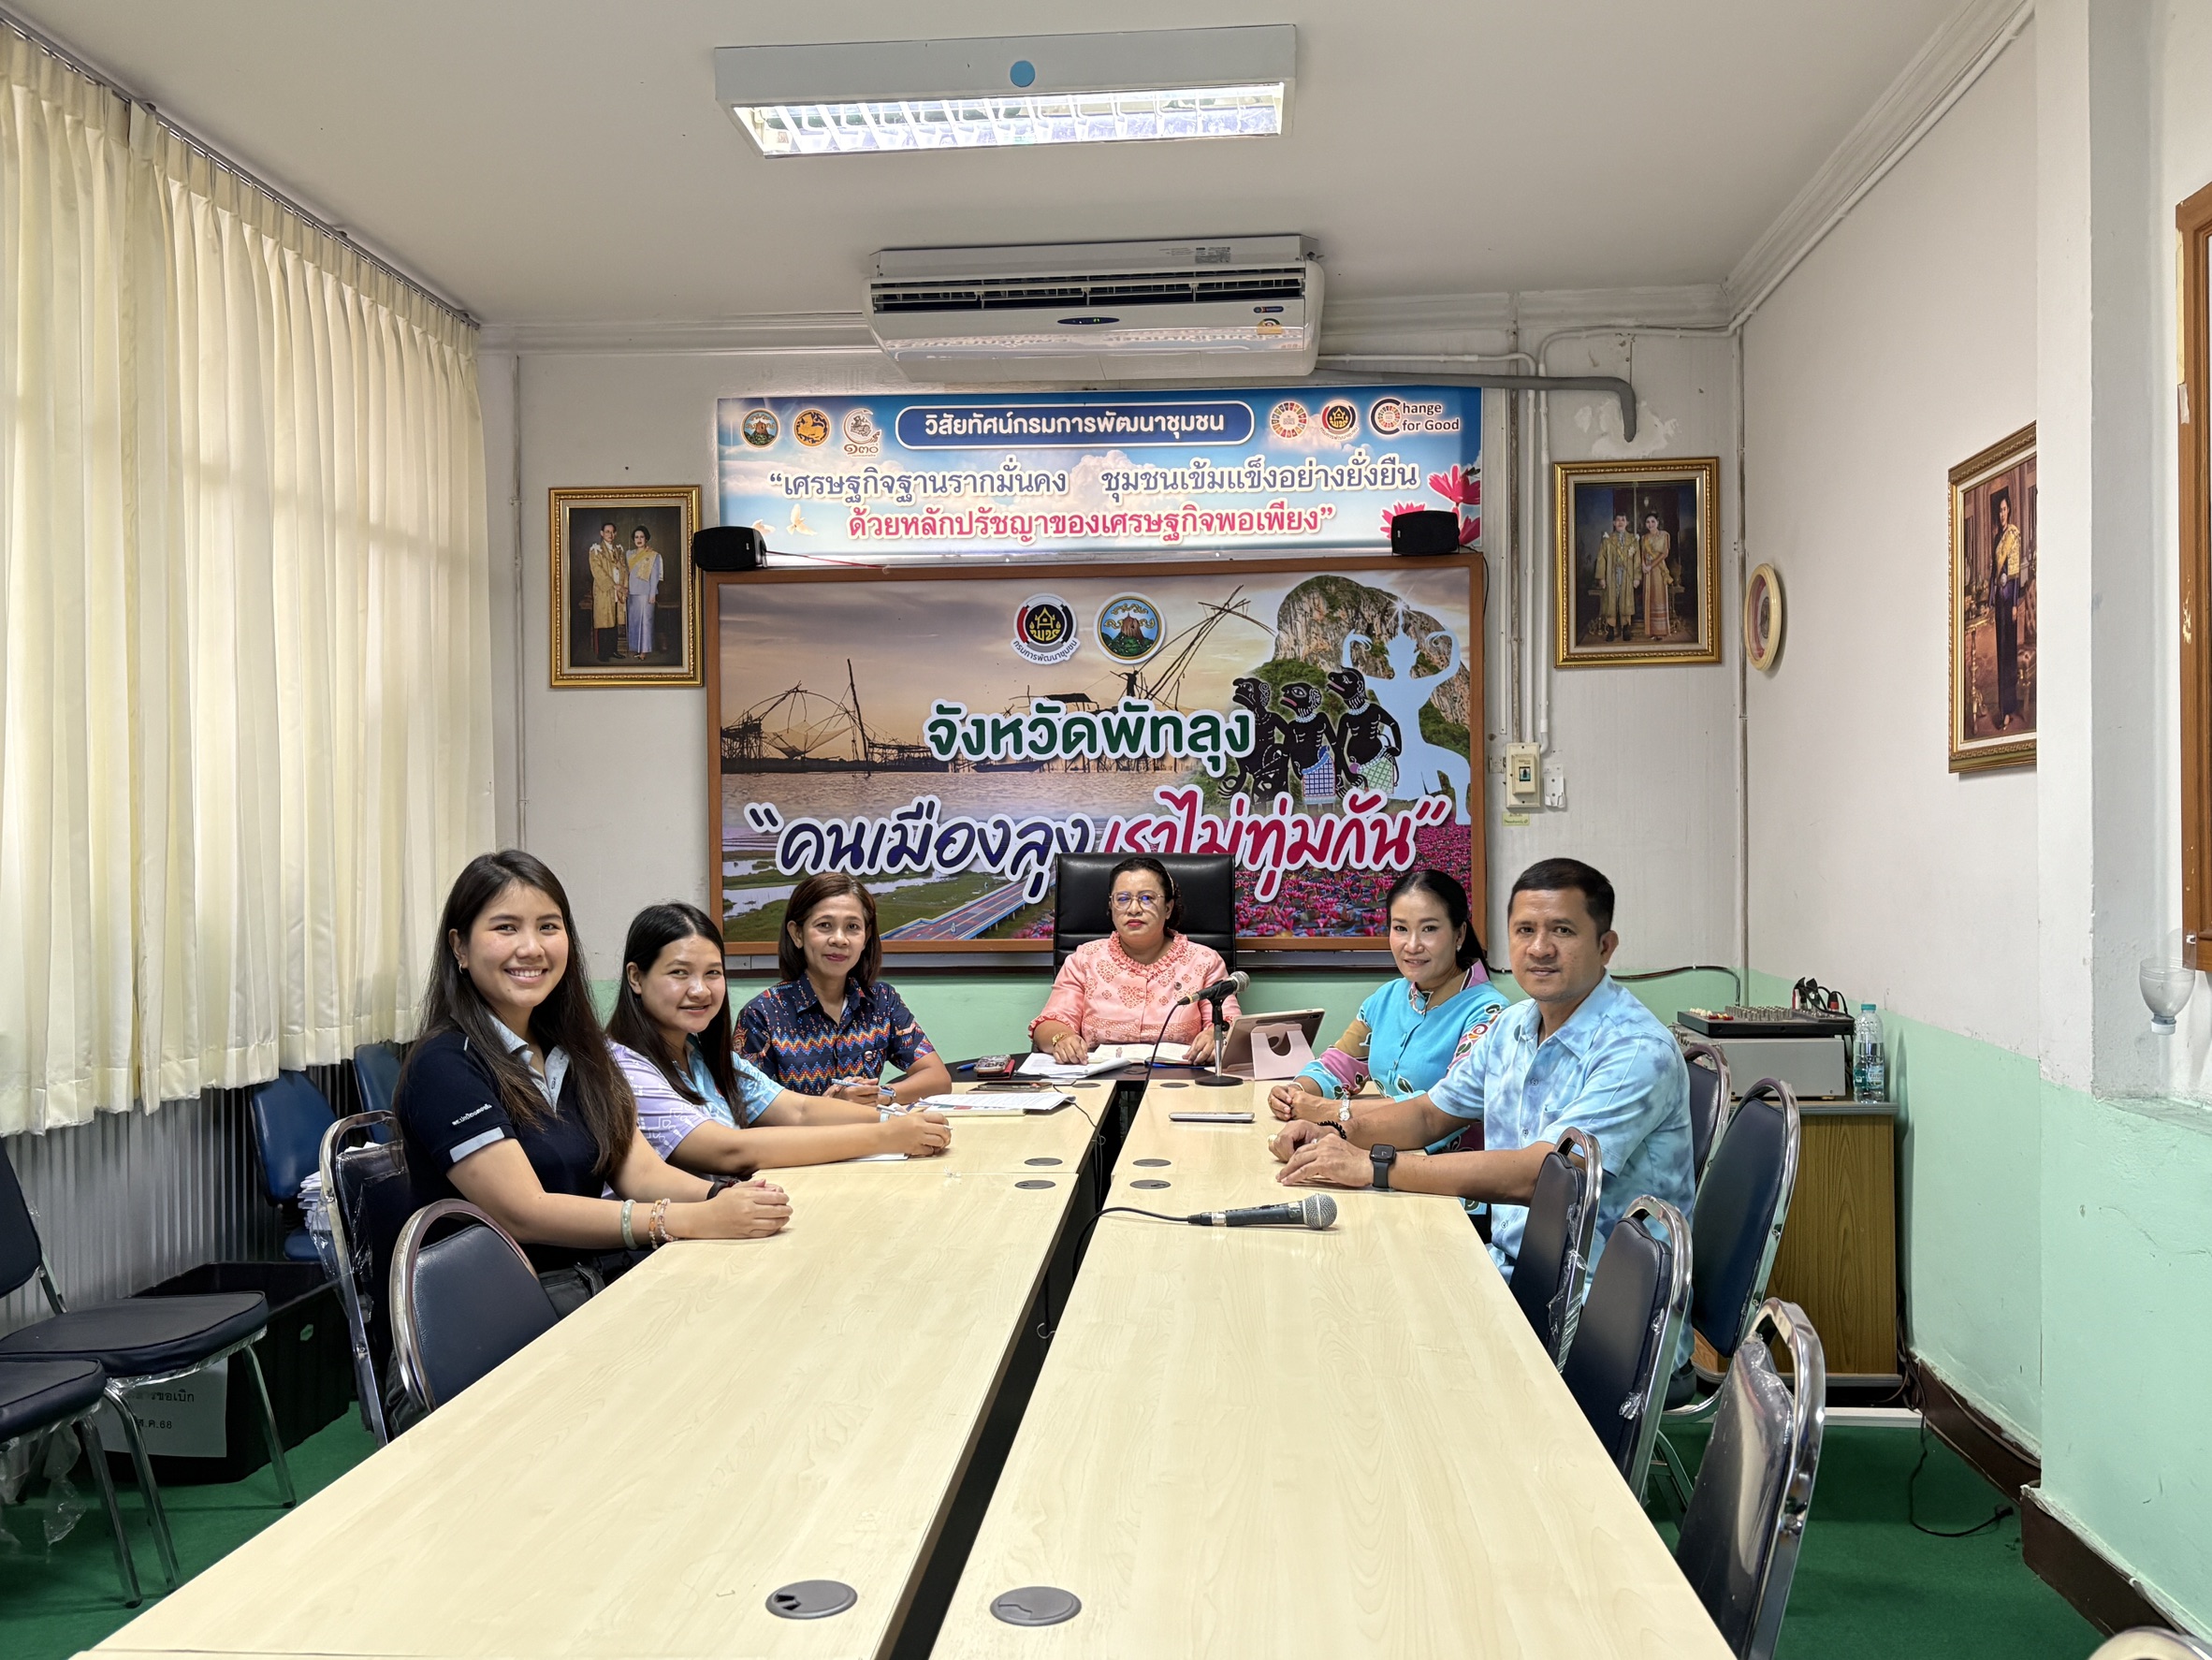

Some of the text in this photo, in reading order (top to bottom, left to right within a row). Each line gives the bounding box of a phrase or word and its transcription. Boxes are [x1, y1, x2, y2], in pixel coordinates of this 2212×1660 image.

[925, 410, 1224, 439] วิสัยทัศน์กรมการพัฒนาชุมชน
[1403, 418, 1460, 431] for Good
[1101, 452, 1417, 502] ชุมชนเข้มแข็งอย่างยั่งยืน
[1012, 640, 1078, 662] กรมการพัฒนาชุมชน
[928, 702, 1248, 772] จังหวัดพัทลุง
